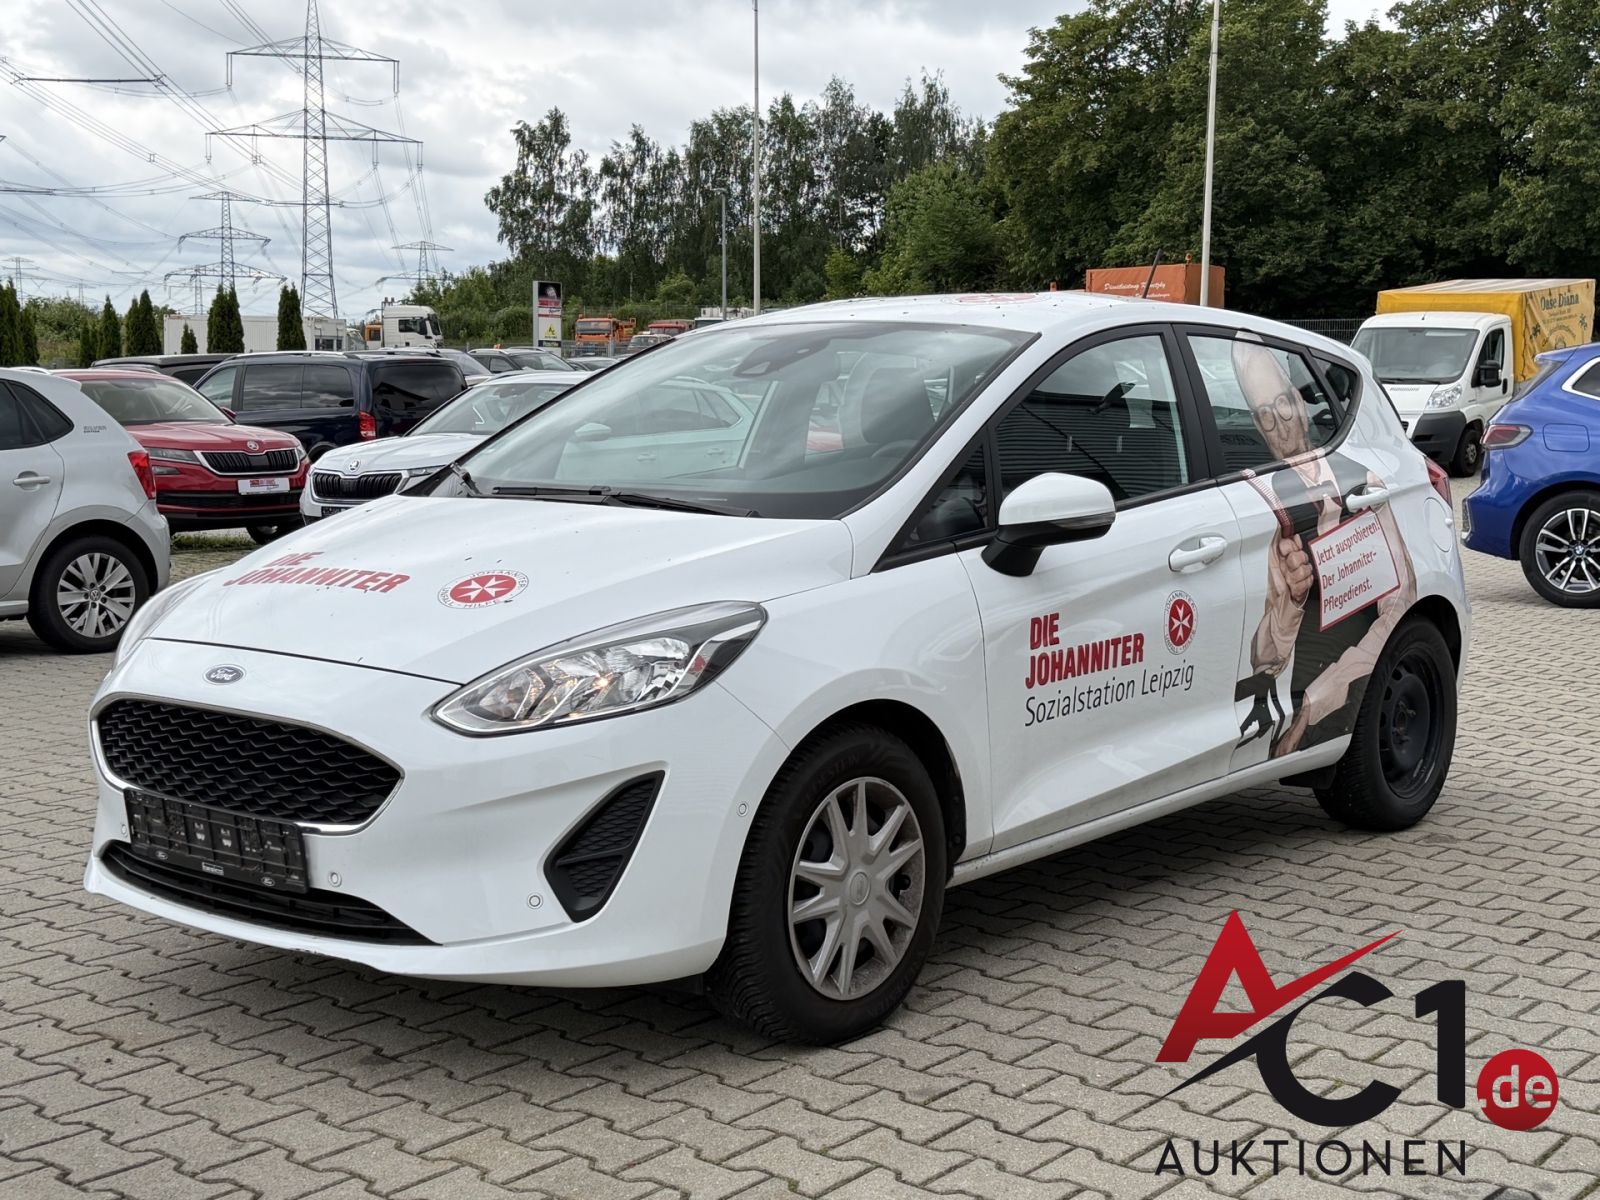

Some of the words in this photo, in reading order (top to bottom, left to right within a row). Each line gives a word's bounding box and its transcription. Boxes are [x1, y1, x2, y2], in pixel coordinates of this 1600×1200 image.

[1540, 296, 1557, 311] Oase
[1558, 292, 1580, 308] Diana
[262, 551, 325, 568] DIE
[1316, 545, 1336, 566] Jetzt
[1336, 517, 1381, 552] ausprobieren!
[223, 567, 411, 594] JOHANNITER
[1321, 572, 1335, 590] Der
[1337, 550, 1377, 582] Johanniter-
[1323, 577, 1373, 614] Pflegedienst.
[1030, 612, 1060, 650] DIE
[1025, 632, 1145, 690] JOHANNITER
[1025, 676, 1136, 727] Sozialstation
[1141, 659, 1195, 697] Leipzig
